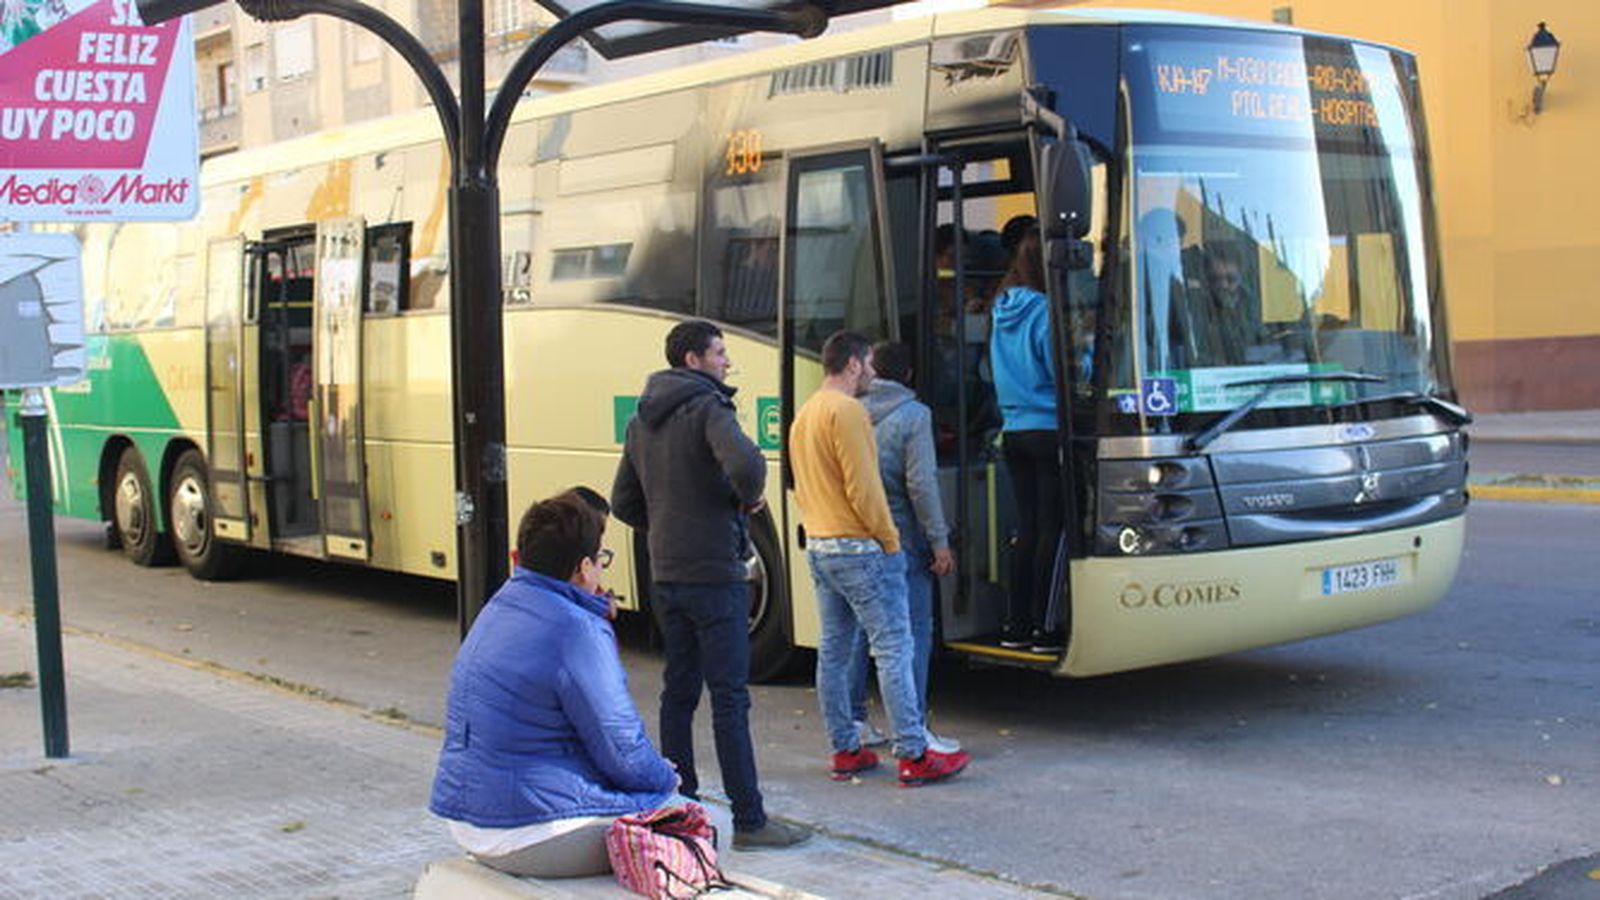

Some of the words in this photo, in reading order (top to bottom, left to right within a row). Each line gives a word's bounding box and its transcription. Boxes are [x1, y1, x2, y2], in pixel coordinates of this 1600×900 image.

[78, 32, 159, 65] FELIZ
[35, 69, 146, 103] CUESTA
[1, 107, 48, 140] UY
[51, 109, 136, 141] POCO
[0, 174, 77, 206] Media
[100, 174, 190, 206] Markt
[1336, 567, 1368, 591] 1423
